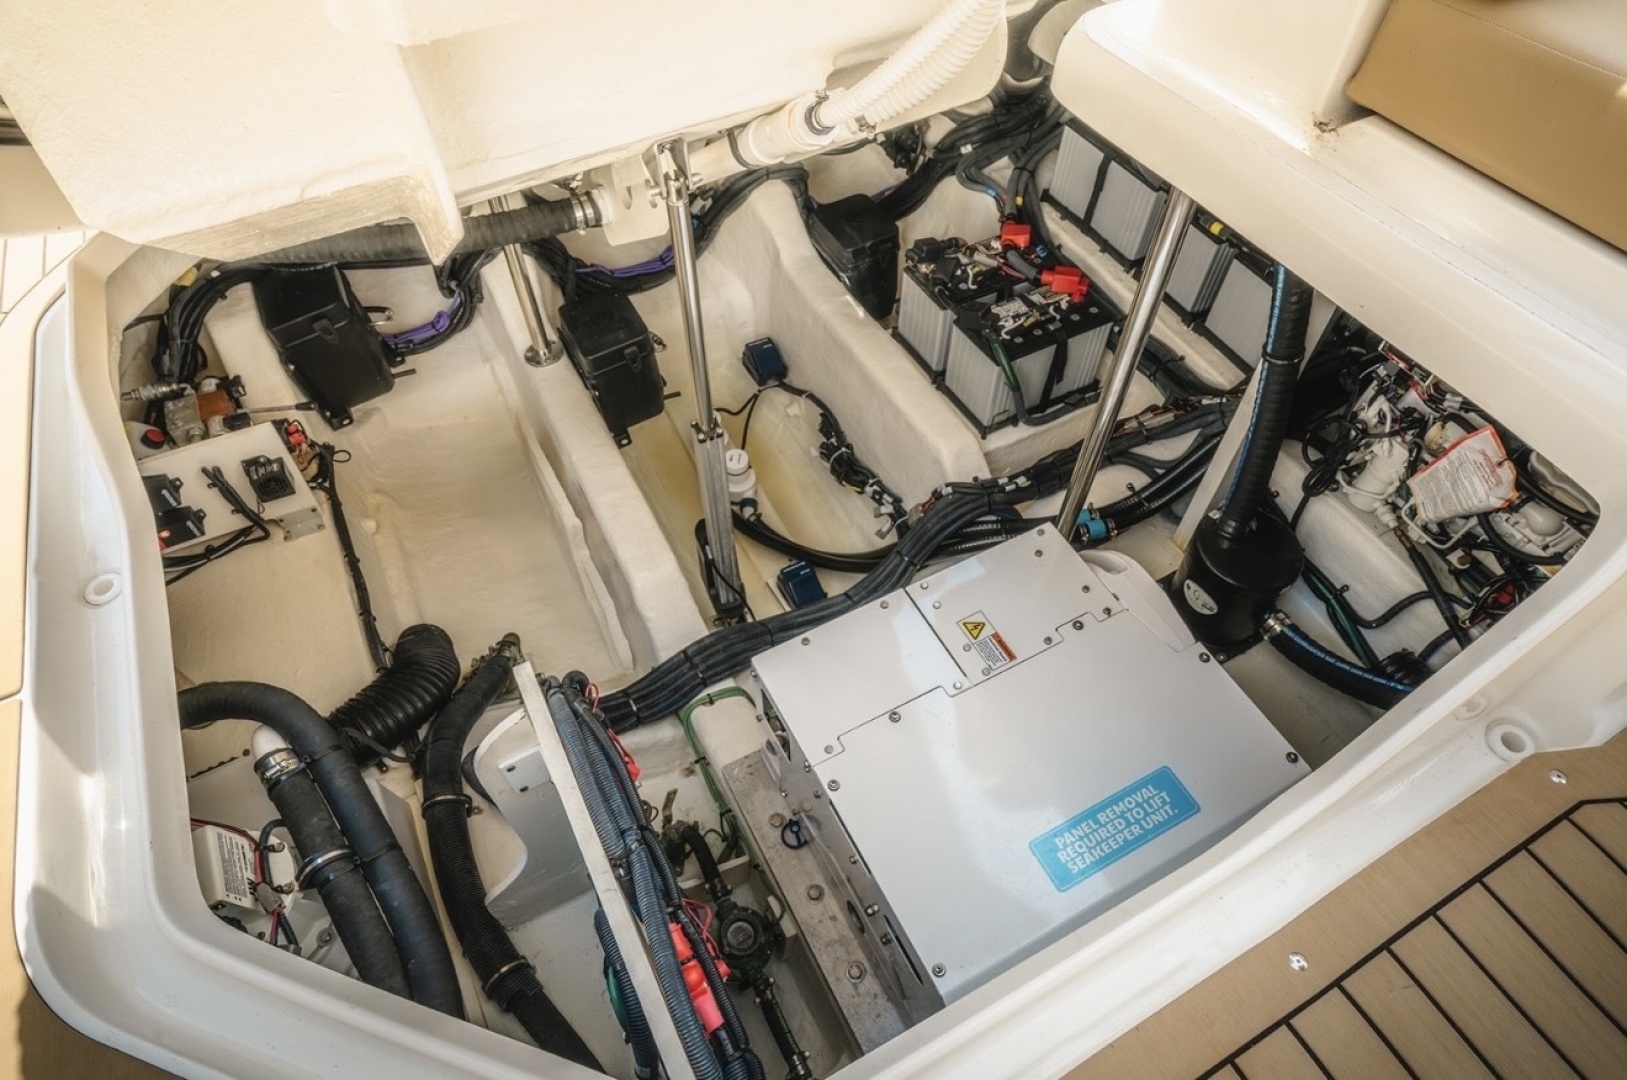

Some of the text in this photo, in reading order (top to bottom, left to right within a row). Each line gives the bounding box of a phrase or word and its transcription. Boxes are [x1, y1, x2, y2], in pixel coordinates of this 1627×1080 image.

[1055, 784, 1159, 849] PANEL REMOVAL
[1057, 790, 1171, 863] REQUIRED TO LIFT
[1067, 804, 1178, 874] SEAKEEPER UNIT.
